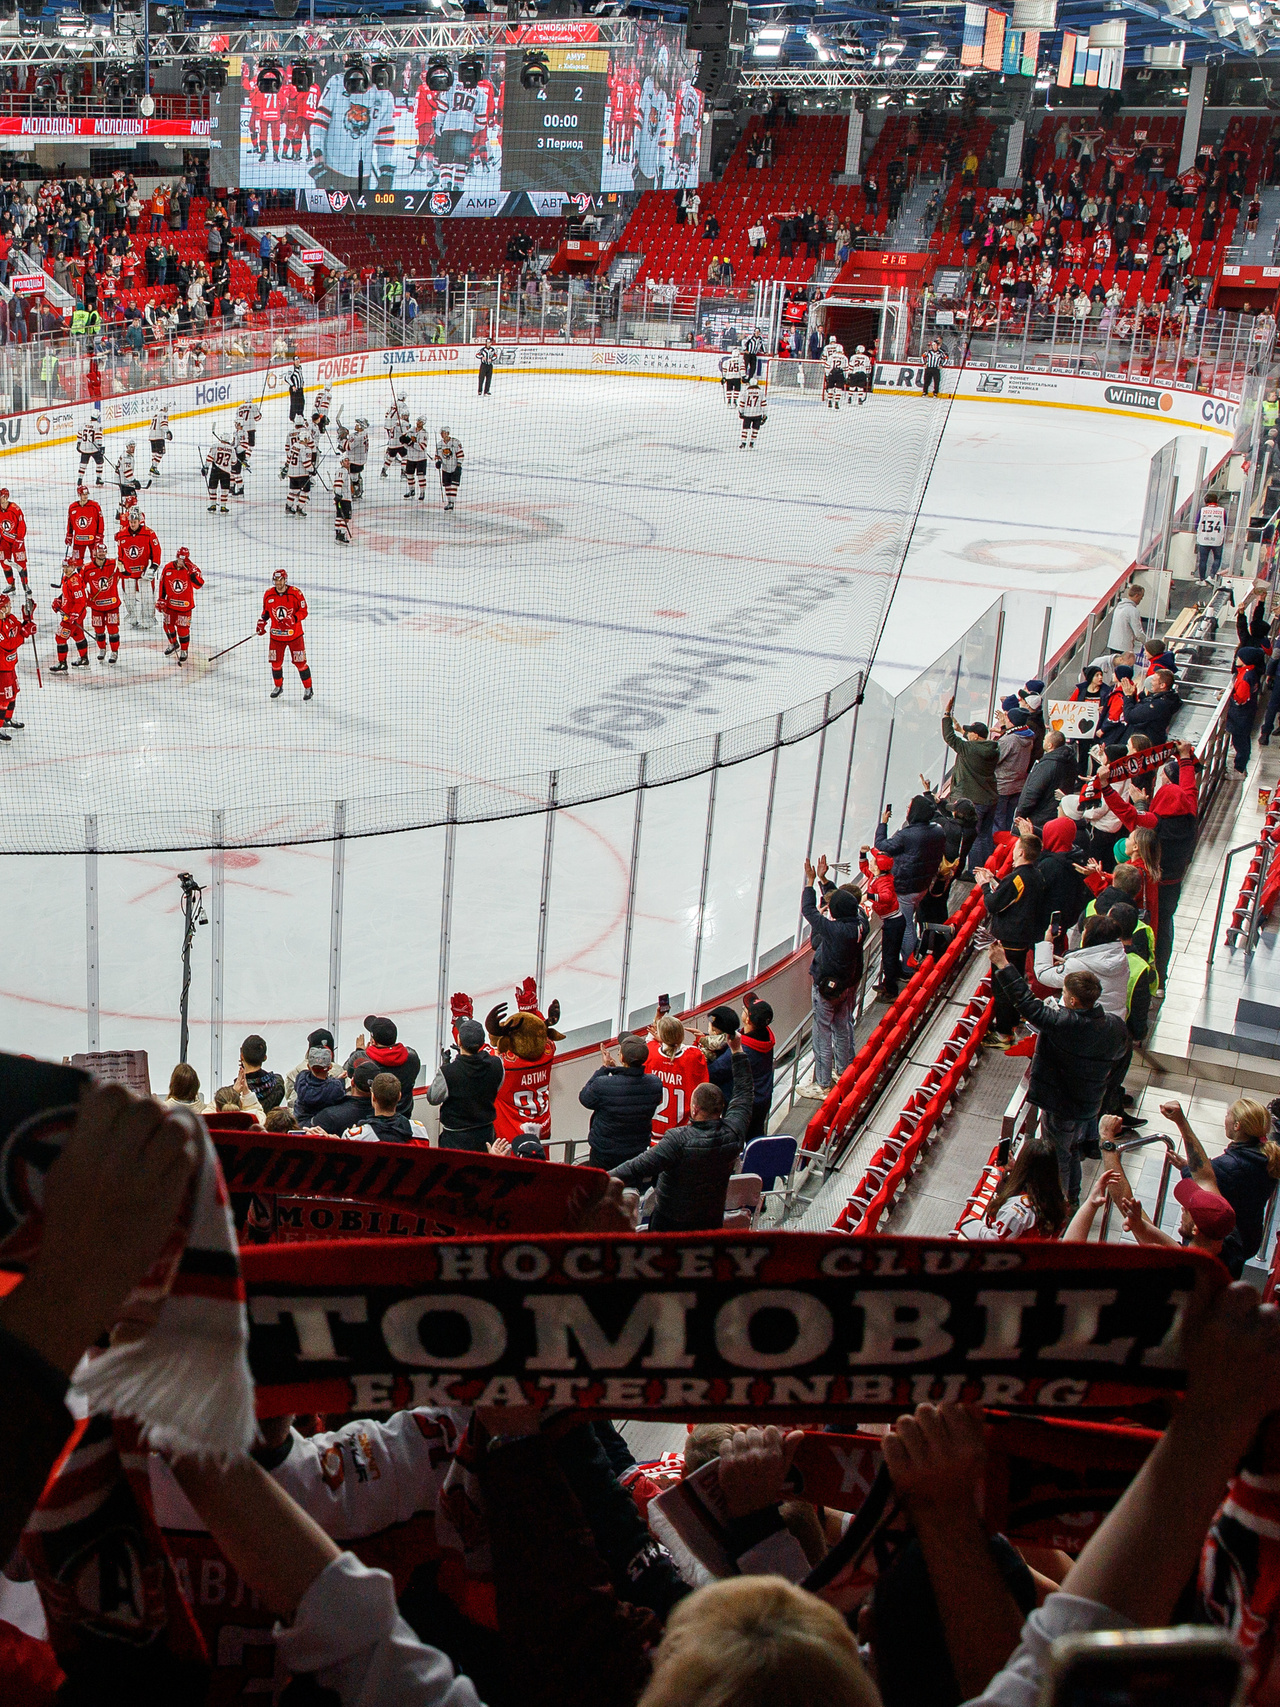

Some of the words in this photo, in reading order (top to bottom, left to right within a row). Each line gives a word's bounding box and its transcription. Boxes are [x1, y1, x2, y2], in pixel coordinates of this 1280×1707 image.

[565, 53, 585, 61] АМУР
[537, 89, 547, 101] 4
[574, 87, 583, 102] 2
[543, 114, 578, 128] 00:00
[537, 138, 544, 149] 3
[547, 138, 583, 150] Период
[357, 194, 367, 209] 4
[374, 193, 395, 204] 0:00
[404, 195, 415, 210] 2
[383, 348, 459, 365] SIMA-LAND
[317, 354, 369, 381] FONBET
[195, 381, 231, 405] Haier
[1109, 387, 1156, 407] Winline
[1201, 520, 1221, 533] 134
[521, 1069, 547, 1086] АВТИК
[651, 1069, 683, 1086] KOVAR
[652, 1088, 685, 1124] 21
[437, 1245, 770, 1283] HOCKEY
[350, 1373, 1089, 1413] EKATERINBURG
